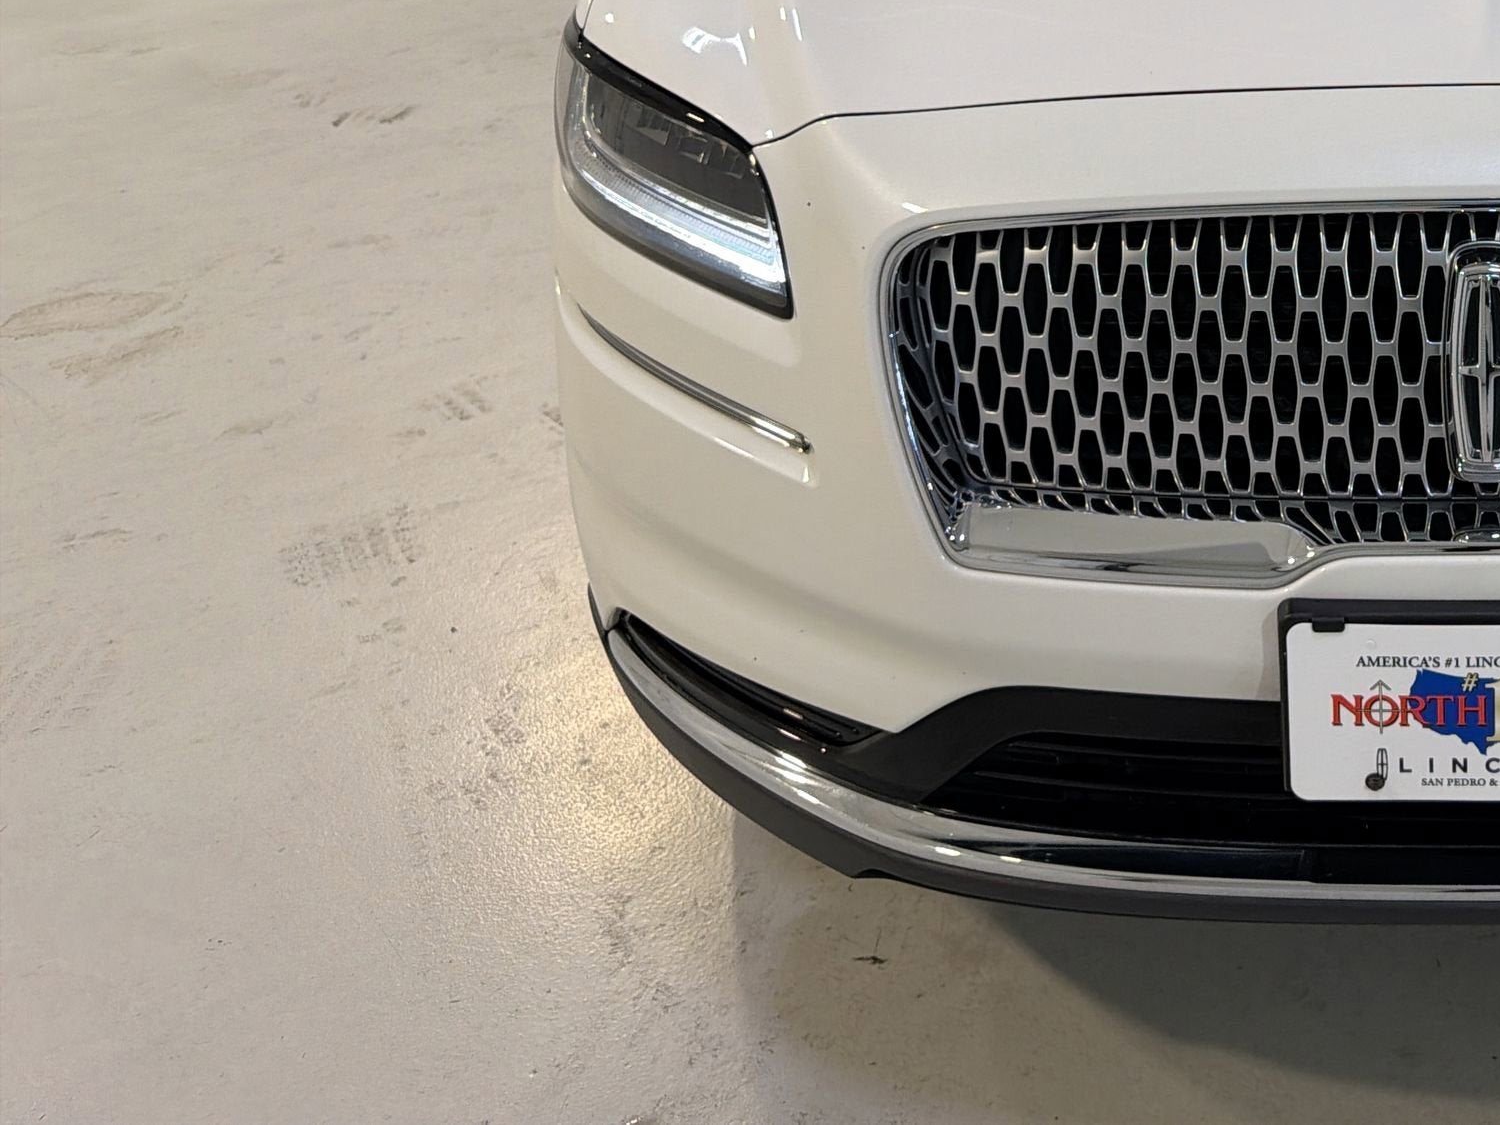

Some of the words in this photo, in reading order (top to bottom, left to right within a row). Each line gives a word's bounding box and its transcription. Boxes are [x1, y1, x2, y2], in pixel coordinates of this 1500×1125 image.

[1355, 655, 1441, 668] AMERICA'S
[1444, 656, 1461, 668] #1
[1330, 693, 1488, 727] NORTH
[1421, 777, 1444, 787] SAN
[1446, 777, 1487, 787] PEDRO
[1488, 777, 1499, 787] &
